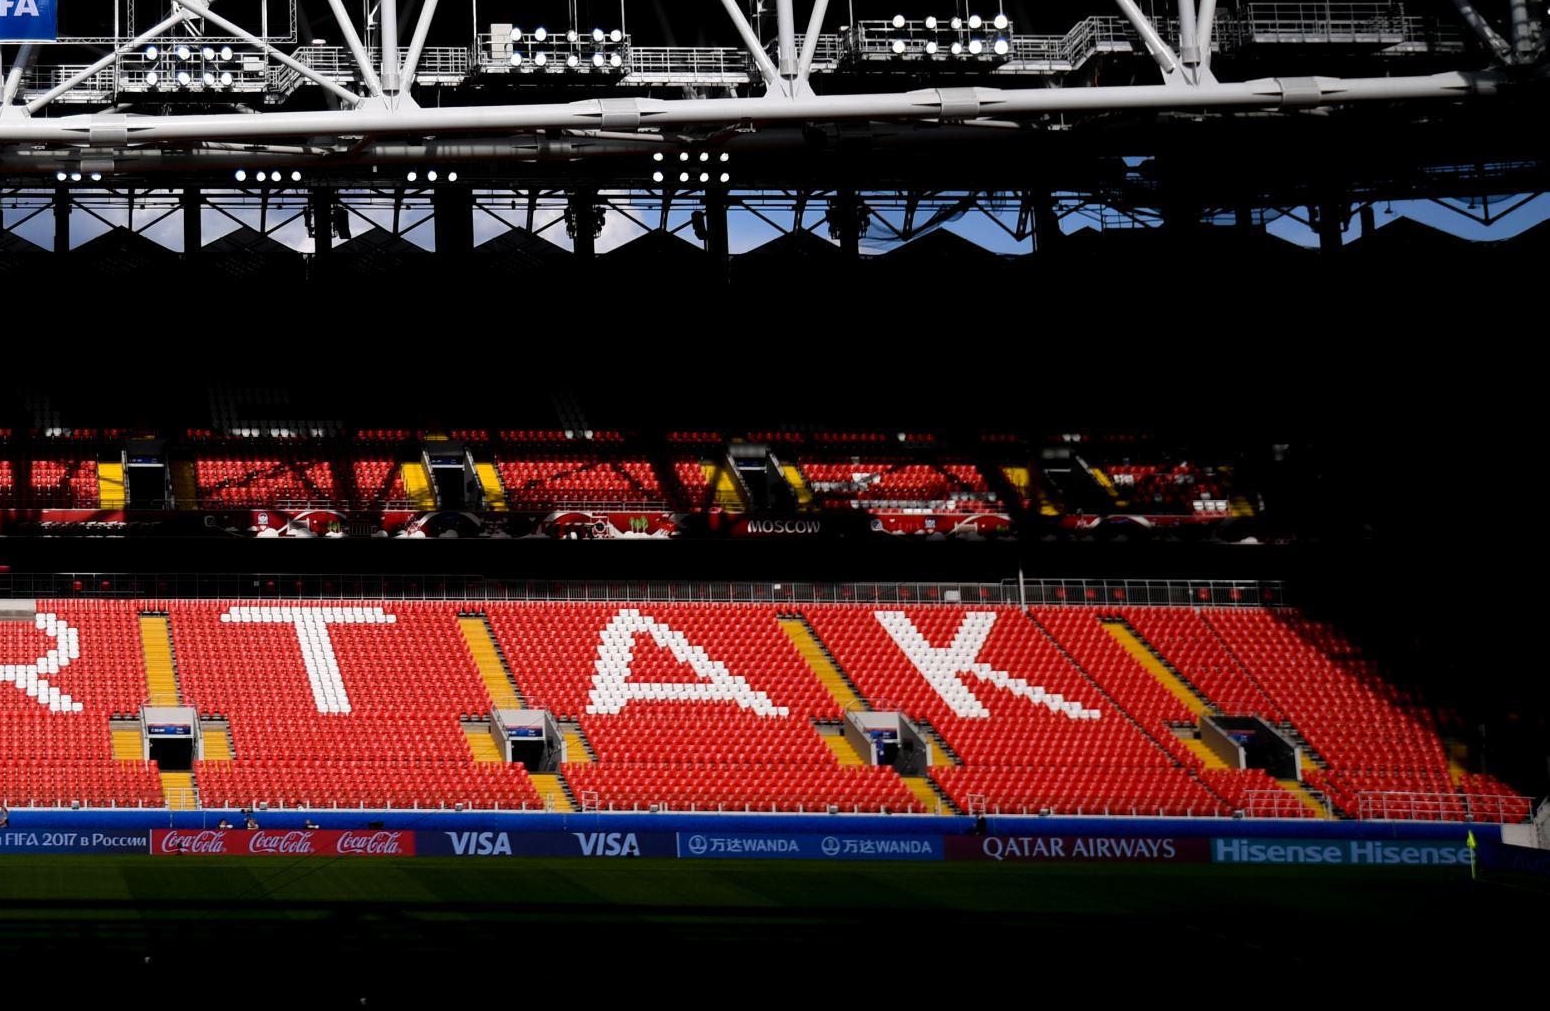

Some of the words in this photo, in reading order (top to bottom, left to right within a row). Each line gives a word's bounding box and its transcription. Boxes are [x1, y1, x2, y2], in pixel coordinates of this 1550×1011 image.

[746, 519, 822, 534] MOSCOW
[5, 832, 39, 846] FIFA
[41, 832, 77, 846] 2017
[80, 836, 90, 846] в
[92, 832, 147, 847] России
[161, 830, 226, 853] Coca-Cola
[249, 830, 314, 853] Coca-Cola
[336, 830, 403, 853] Coca-Cola
[443, 831, 513, 855] VISA
[571, 832, 641, 856] VISA
[982, 836, 1066, 860] QATAR
[1071, 837, 1177, 858] AIRWAYS
[1216, 838, 1343, 863] Hisense
[1351, 840, 1477, 864] Hisense
